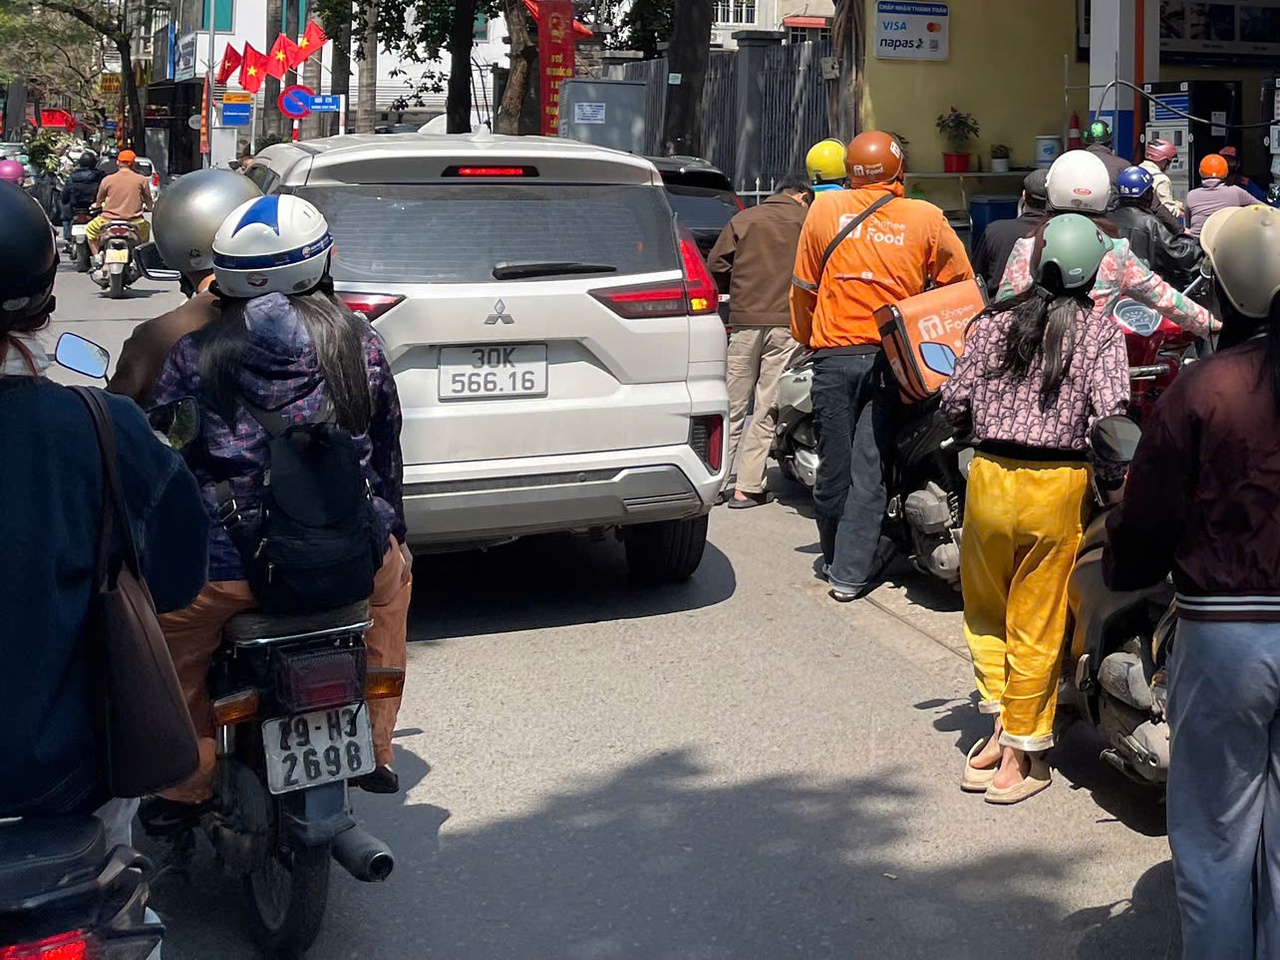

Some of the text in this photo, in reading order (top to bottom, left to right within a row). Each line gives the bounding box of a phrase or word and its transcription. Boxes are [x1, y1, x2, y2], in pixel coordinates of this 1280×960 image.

[882, 21, 907, 30] VISA
[880, 39, 914, 51] napas
[866, 166, 883, 176] Food
[867, 227, 905, 245] Food
[471, 347, 516, 369] 30K
[451, 371, 535, 394] 566.16
[282, 740, 362, 787] 2698
